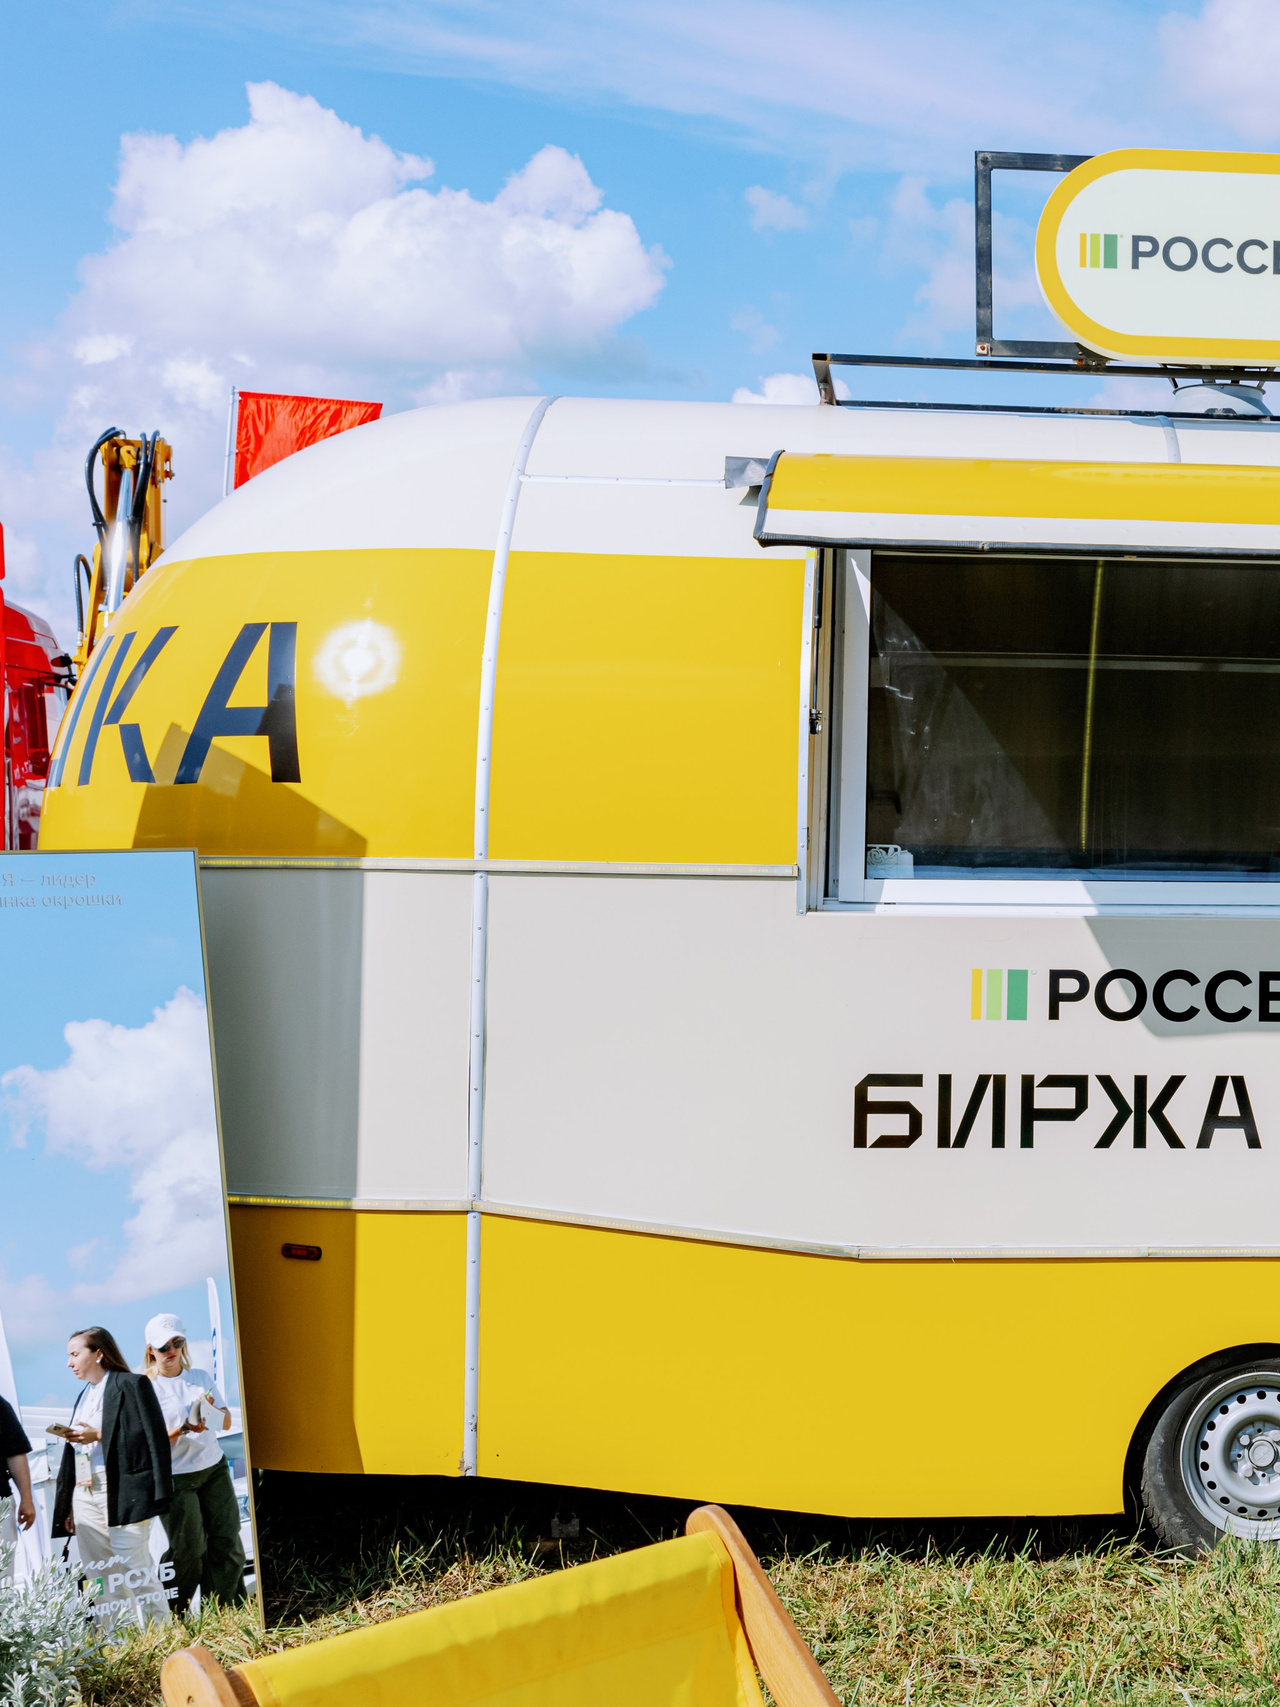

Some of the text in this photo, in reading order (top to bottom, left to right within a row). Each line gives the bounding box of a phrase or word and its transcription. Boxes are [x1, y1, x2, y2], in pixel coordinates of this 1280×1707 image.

[41, 874, 98, 889] лидер
[42, 894, 122, 910] окрошки
[853, 1073, 1262, 1149] БИРЖА
[108, 1561, 176, 1593] РСХБ
[136, 1587, 179, 1605] СТОЛЕ
